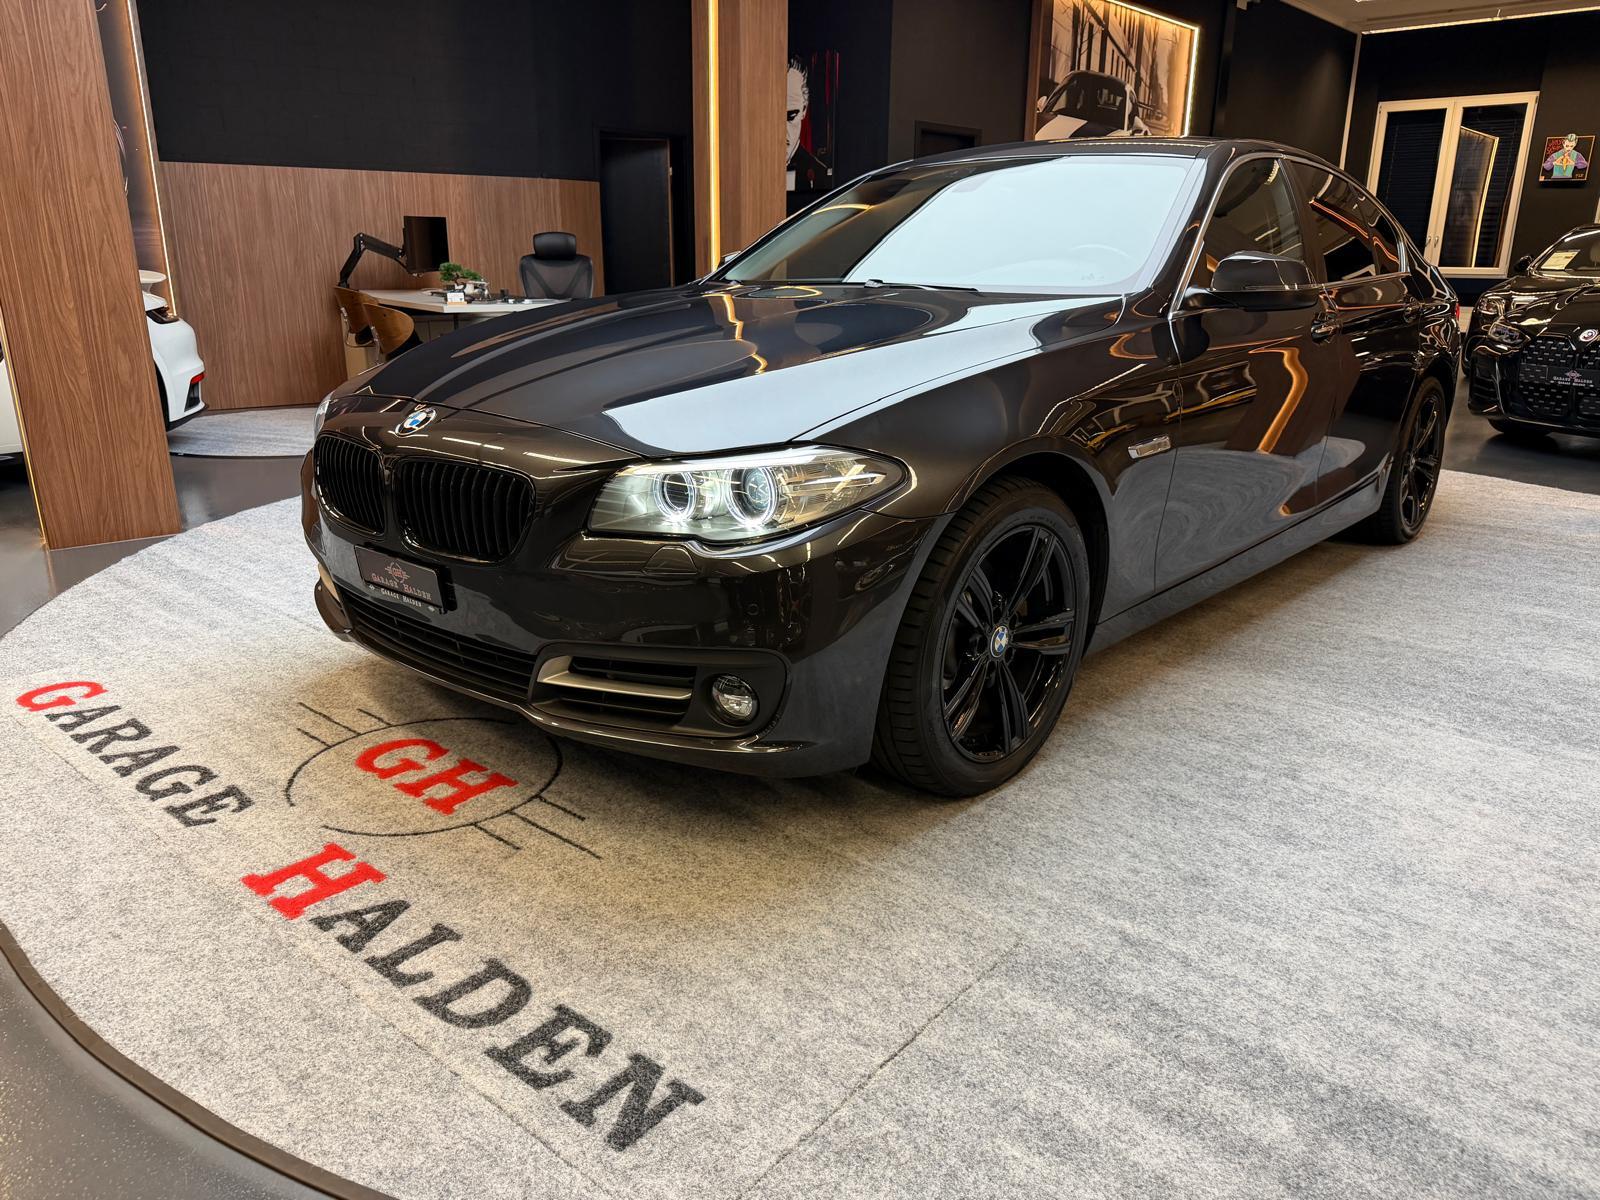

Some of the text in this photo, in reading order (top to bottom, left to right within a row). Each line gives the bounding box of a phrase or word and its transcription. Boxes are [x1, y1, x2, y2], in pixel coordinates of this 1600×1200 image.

[355, 738, 518, 815] GH
[17, 681, 706, 1152] GARAGE HALDEN
